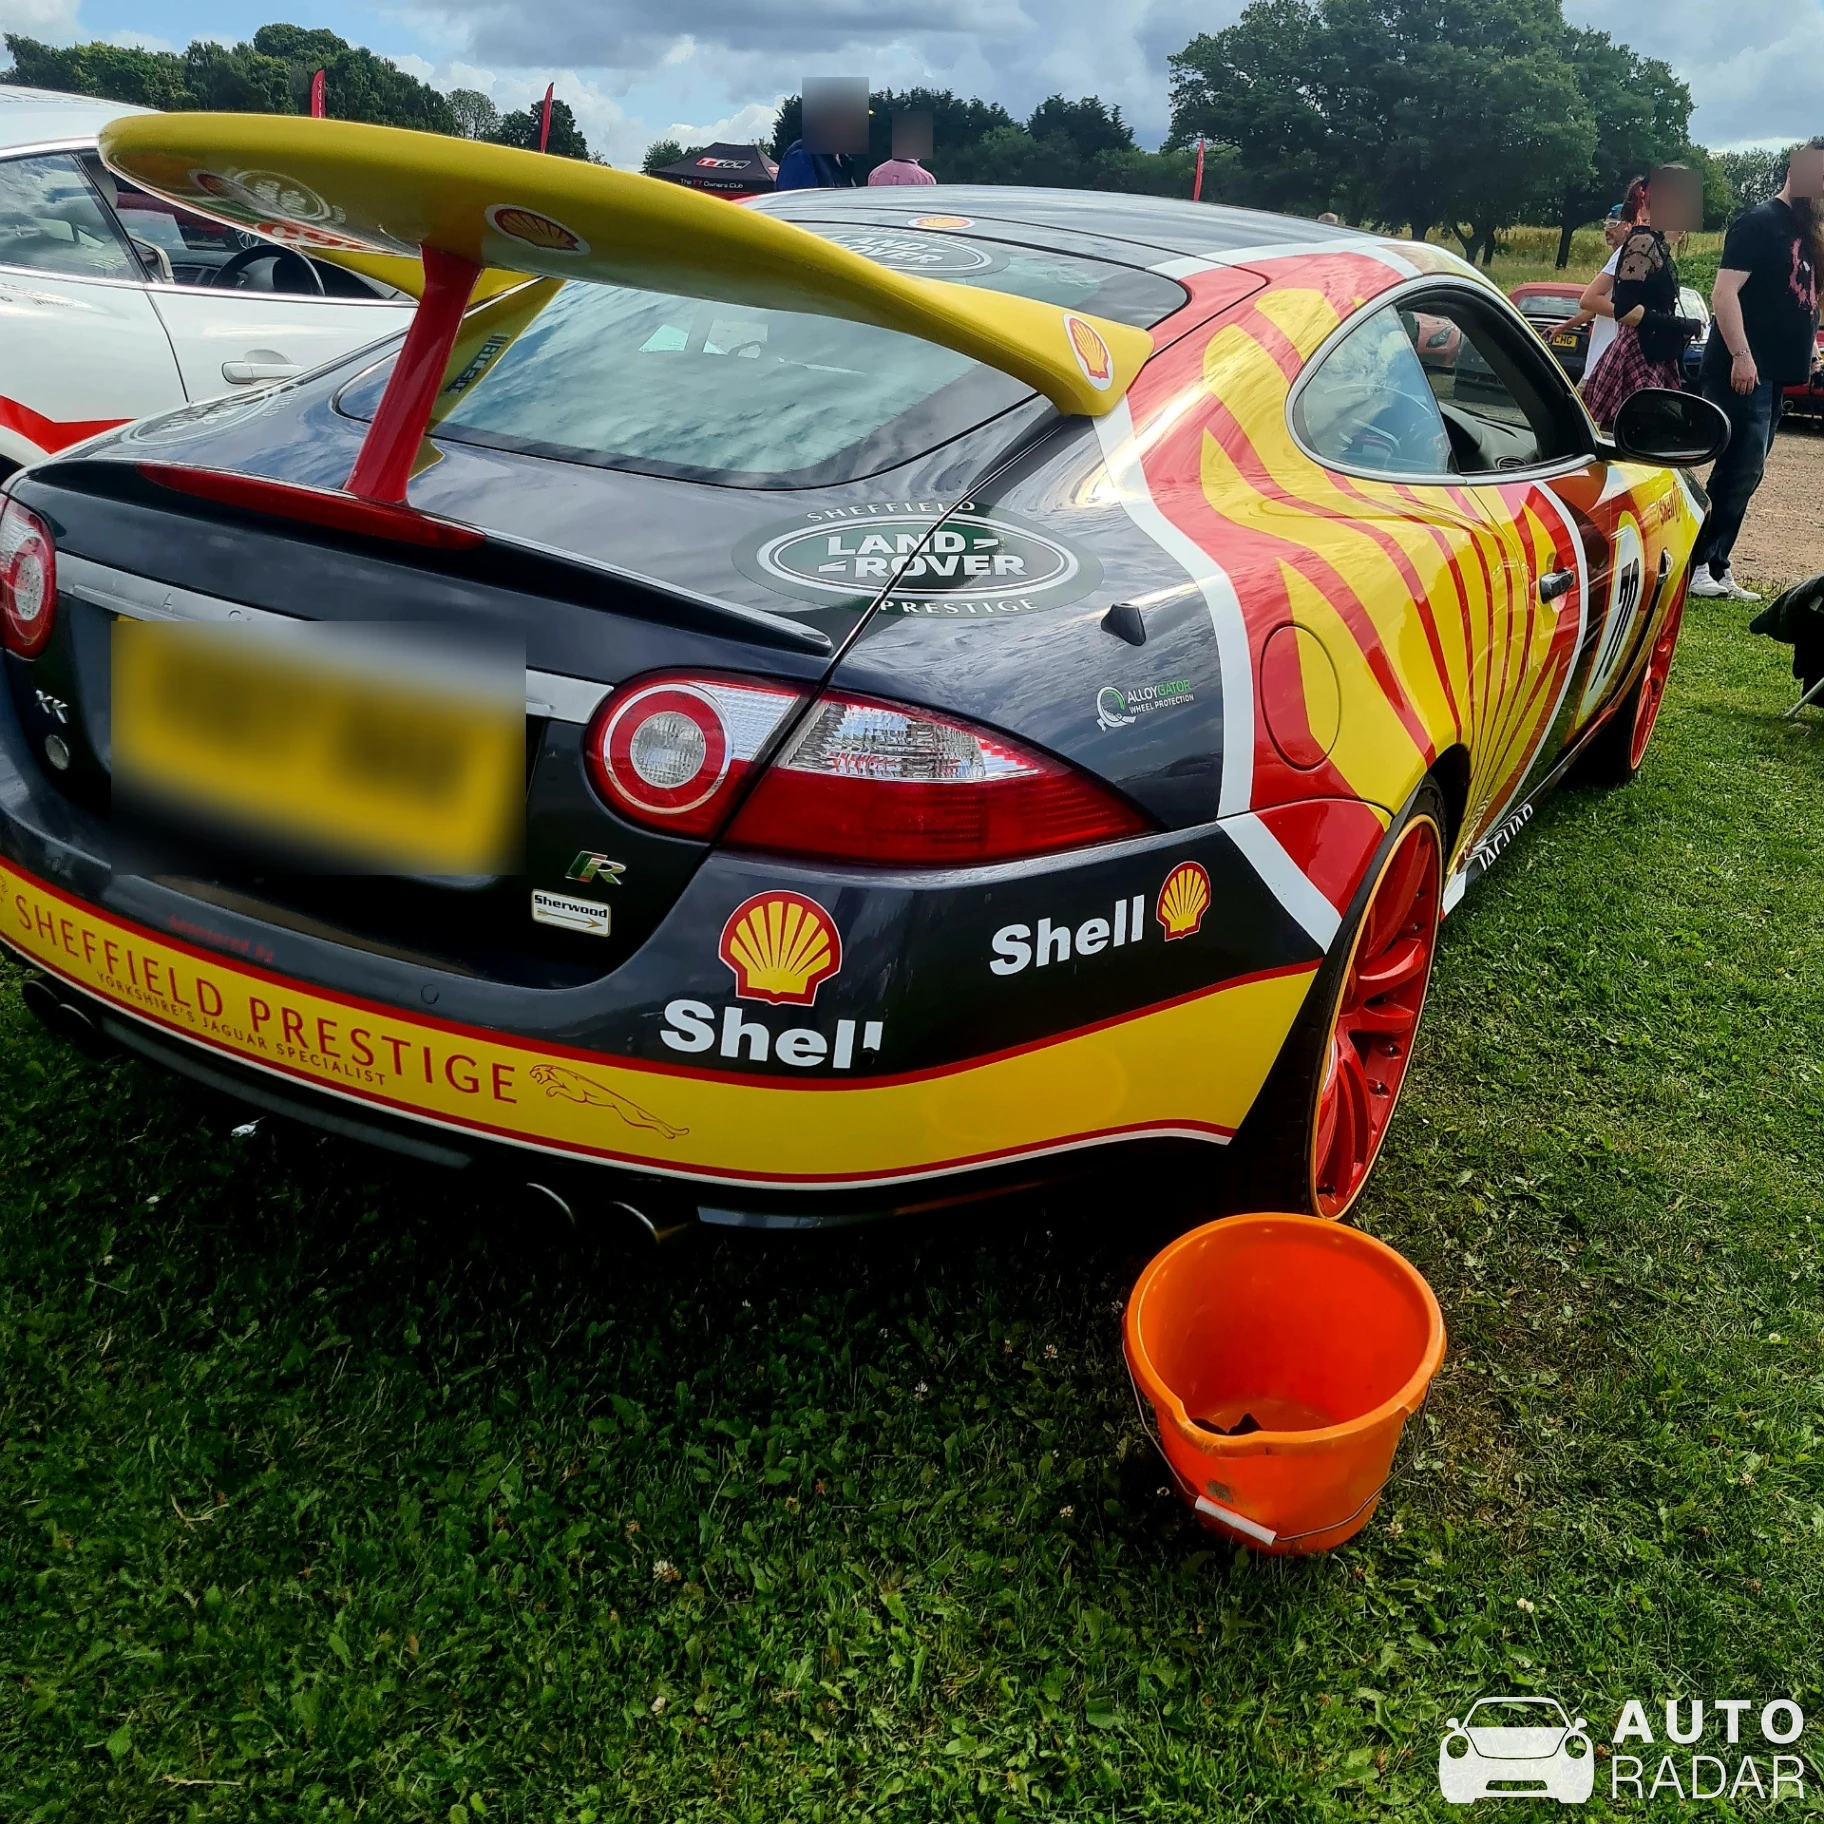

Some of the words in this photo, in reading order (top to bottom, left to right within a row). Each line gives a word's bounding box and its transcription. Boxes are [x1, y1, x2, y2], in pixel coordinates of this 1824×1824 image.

[829, 235, 929, 250] LAND
[849, 246, 944, 264] OVER
[806, 500, 976, 522] SHEFFIELD
[827, 531, 967, 556] LAND
[854, 555, 1029, 578] ROVER
[880, 598, 1038, 615] PRESTIGE
[1127, 679, 1191, 704] ALLOYGATOR
[1128, 702, 1154, 715] WHEEL
[1154, 694, 1194, 709] PROTECTION
[534, 894, 608, 918] Sherwood
[989, 894, 1144, 976] Shell
[15, 894, 223, 1017] SHEFFIELD
[249, 996, 518, 1104] PRESTIGE
[96, 971, 195, 1023] YORKSHIRE'S
[202, 1017, 268, 1050] JAGUAR
[275, 1043, 386, 1086] SPECIALIST
